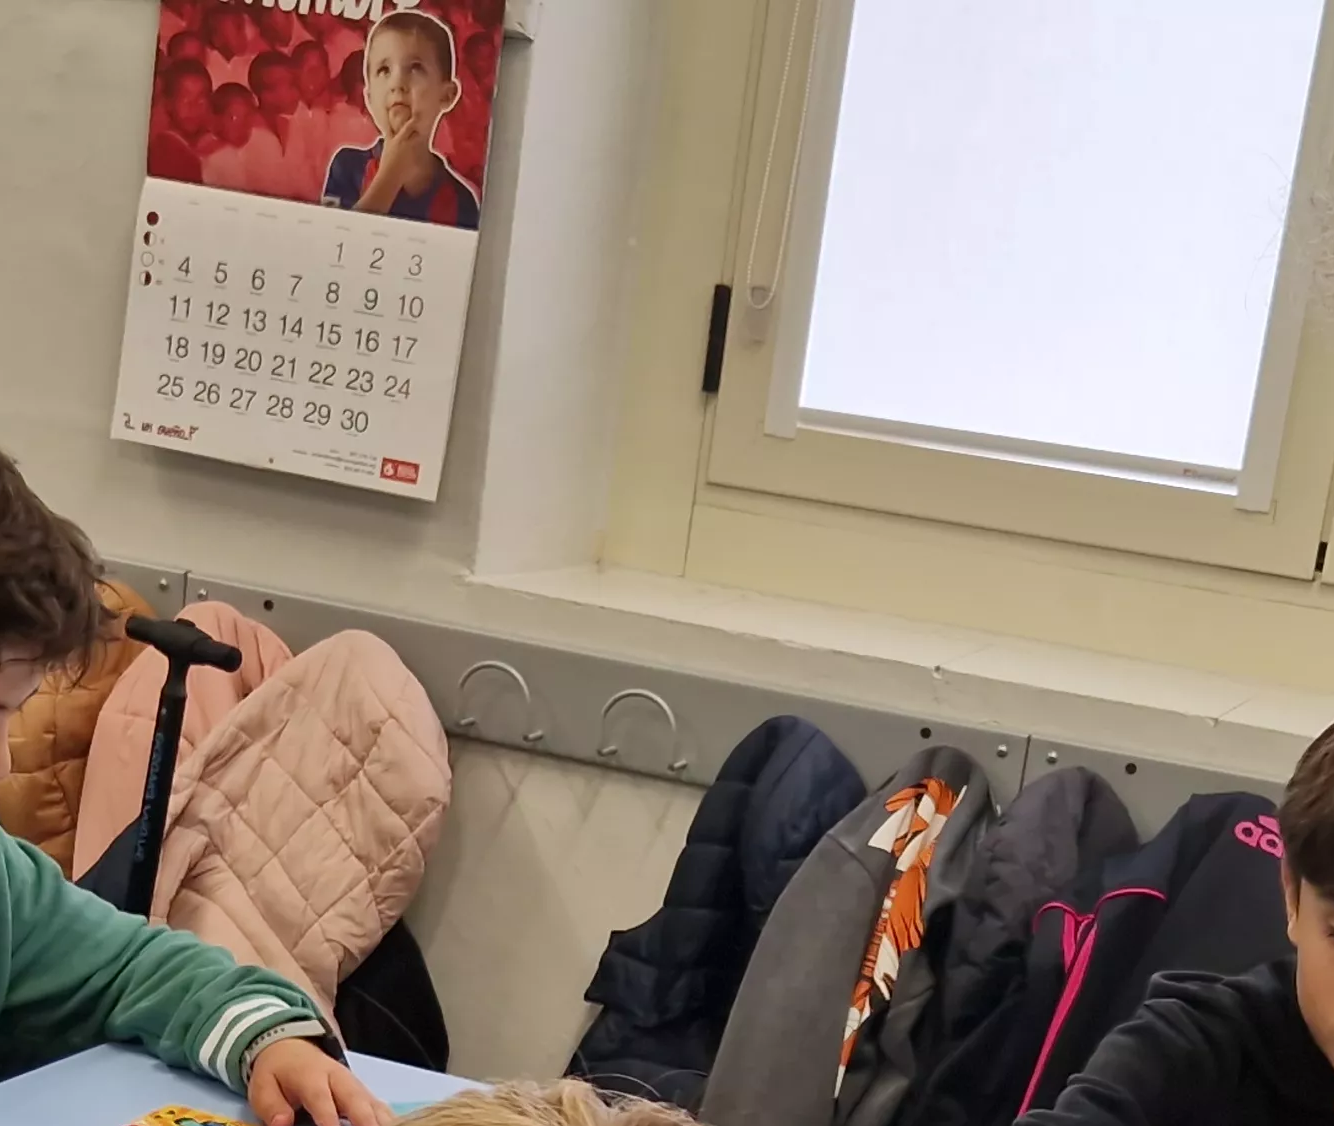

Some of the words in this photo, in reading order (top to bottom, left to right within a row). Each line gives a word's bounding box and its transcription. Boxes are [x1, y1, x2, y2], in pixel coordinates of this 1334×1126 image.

[177, 256, 190, 277] 4
[214, 262, 228, 284] 5
[251, 268, 265, 291] 6
[290, 274, 303, 296] 7
[325, 281, 340, 304] 8
[364, 288, 379, 311] 9
[398, 294, 424, 319] 10
[335, 242, 344, 263] 1
[369, 247, 385, 270] 2
[408, 254, 423, 276] 3
[169, 294, 191, 319] 11
[206, 301, 230, 326] 12
[242, 308, 267, 333] 13
[279, 314, 303, 339] 14
[316, 321, 342, 346] 15
[355, 328, 380, 353] 16
[392, 335, 419, 359] 17
[165, 334, 189, 359] 18
[201, 341, 225, 365] 19
[234, 347, 262, 372] 20
[270, 355, 296, 379] 21
[308, 361, 337, 387] 22
[345, 368, 374, 394] 23
[383, 375, 411, 400] 24
[157, 374, 184, 398] 25
[193, 380, 220, 405] 26
[229, 387, 257, 411] 27
[265, 394, 294, 419] 28
[302, 401, 332, 426] 29
[340, 408, 369, 434] 30
